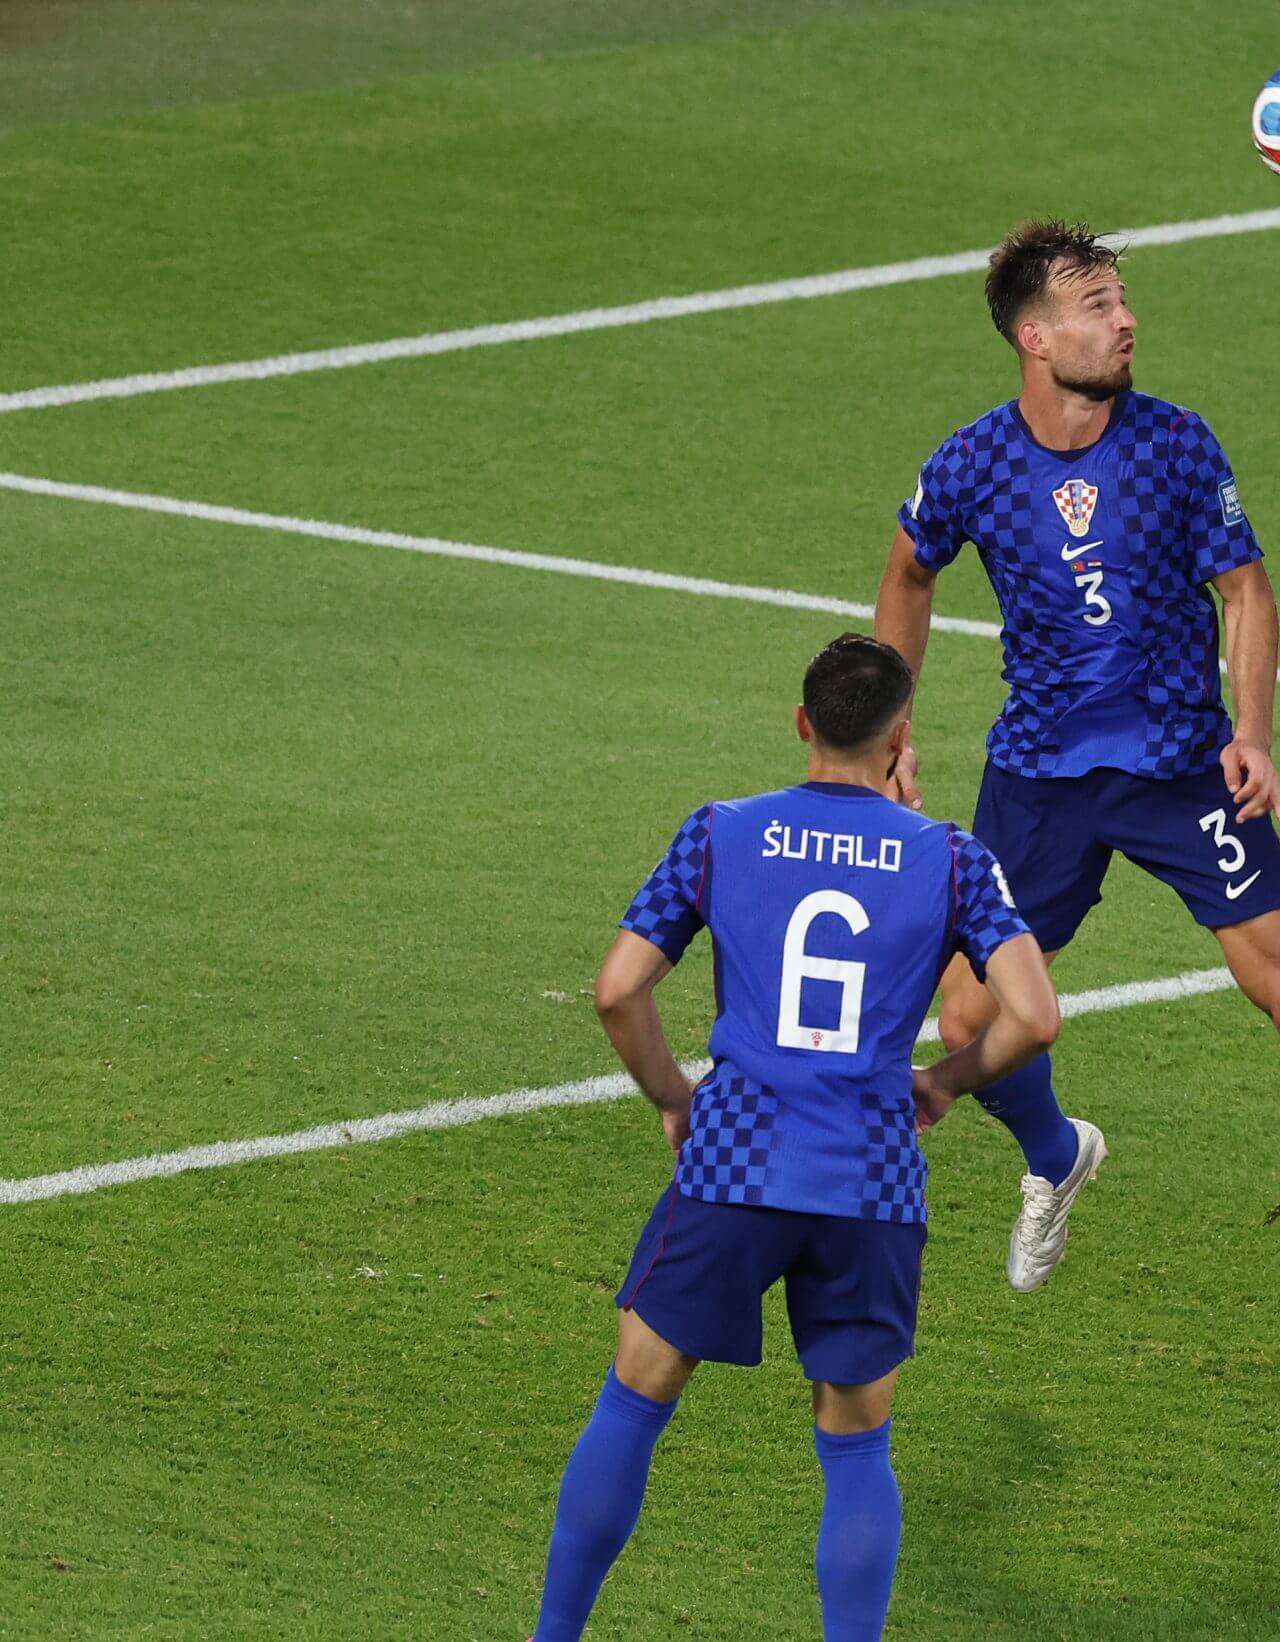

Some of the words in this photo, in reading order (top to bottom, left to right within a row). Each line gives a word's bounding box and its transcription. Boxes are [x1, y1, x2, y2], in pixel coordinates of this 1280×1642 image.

[1075, 570, 1112, 626] 3
[1198, 807, 1246, 873] 3
[776, 889, 871, 1054] 6
